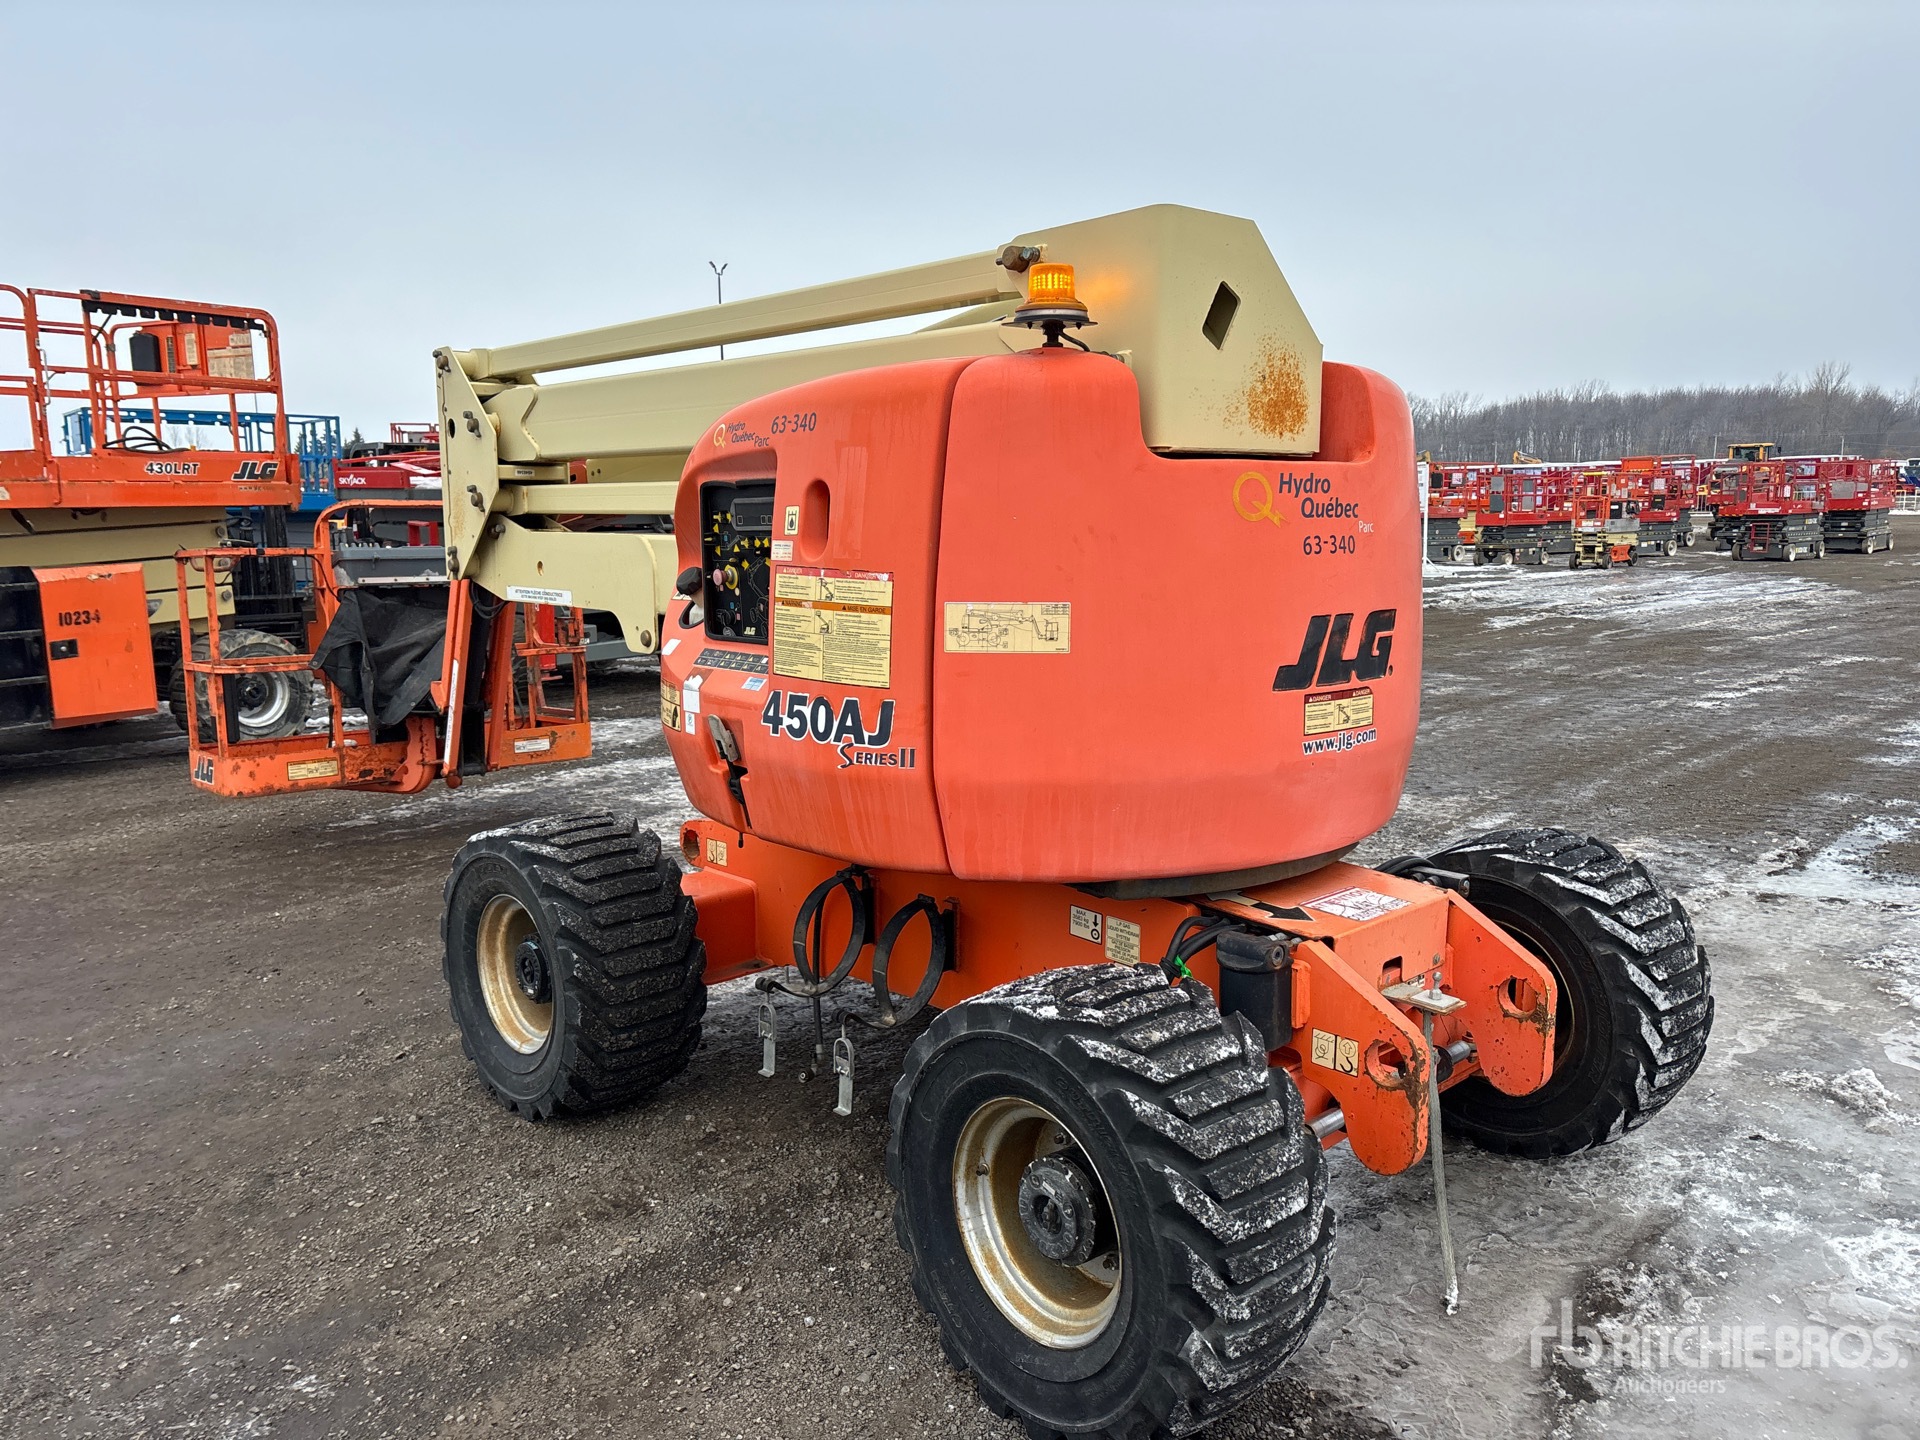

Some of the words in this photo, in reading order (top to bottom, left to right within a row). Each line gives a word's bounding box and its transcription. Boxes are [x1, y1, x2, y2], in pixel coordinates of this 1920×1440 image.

[727, 422, 745, 434] Hydro
[771, 412, 817, 434] 63-340
[731, 432, 755, 443] Québec
[754, 435, 770, 447] Parc
[144, 461, 199, 475] 430LRT
[231, 460, 279, 482] JLG
[339, 474, 366, 487] SKYJACK
[1278, 472, 1331, 498] Hydro
[1301, 497, 1359, 518] Québec
[1358, 520, 1374, 533] Parc
[1303, 535, 1356, 555] 63-340
[847, 605, 860, 613] MISE
[58, 608, 101, 627] 10234
[744, 626, 756, 635] JLG
[1272, 608, 1396, 691] JLG
[1355, 688, 1370, 696] DANGER
[761, 690, 896, 748] 450AJ
[1303, 728, 1377, 755] www.jlg.com
[193, 755, 215, 786] JLG
[1076, 909, 1086, 917] MAX
